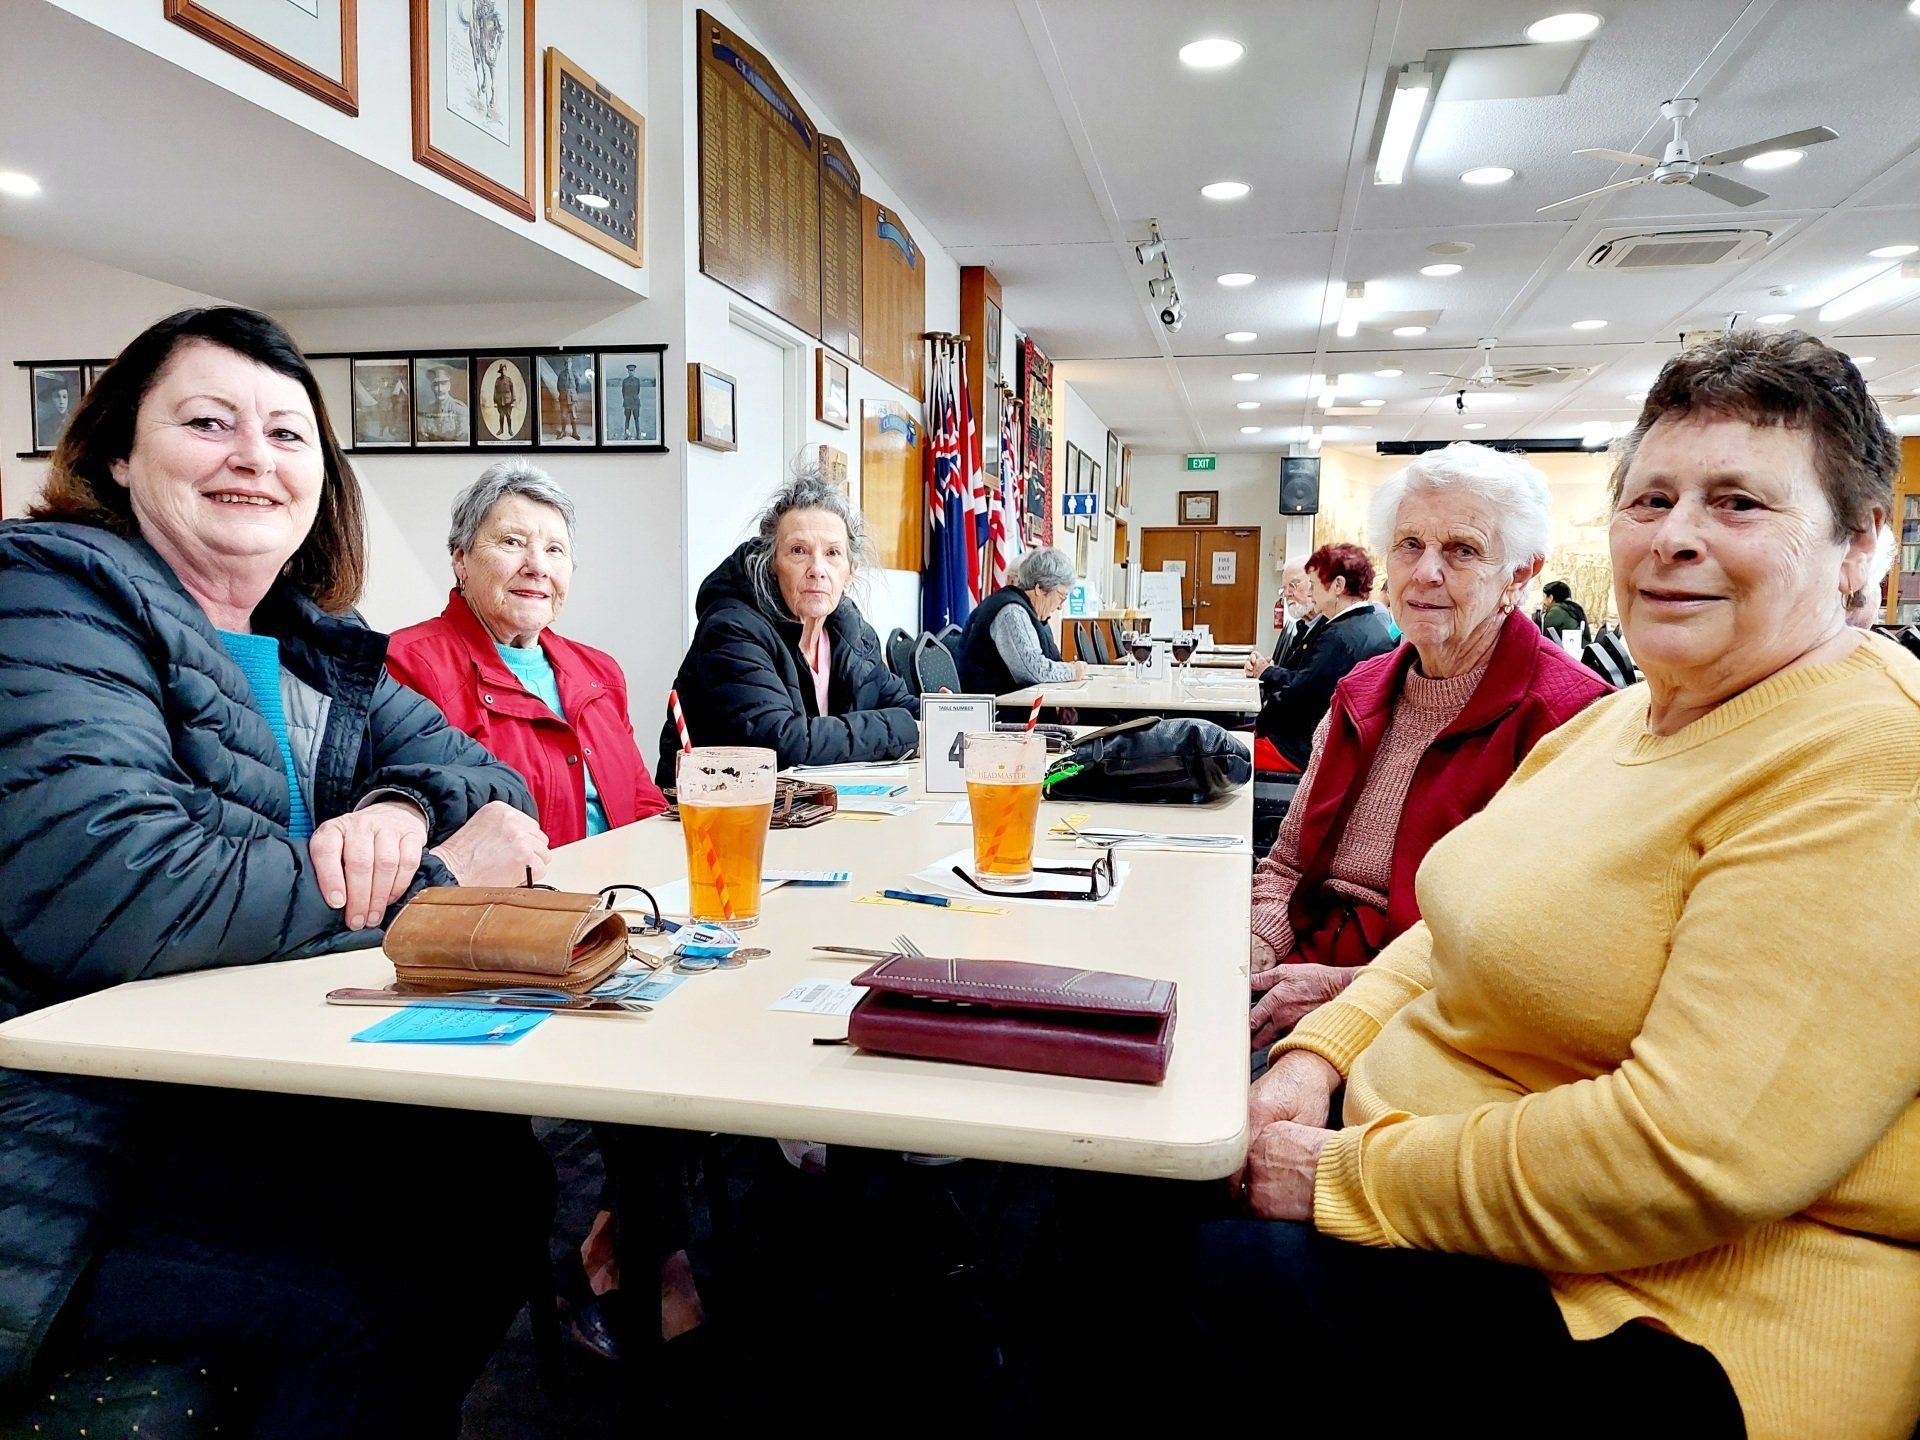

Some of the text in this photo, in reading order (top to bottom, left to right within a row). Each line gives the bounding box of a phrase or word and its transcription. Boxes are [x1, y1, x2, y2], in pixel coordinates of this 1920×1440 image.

[1193, 459, 1210, 469] EXIT
[948, 731, 966, 769] 4
[978, 771, 1027, 780] HEADMASTER
